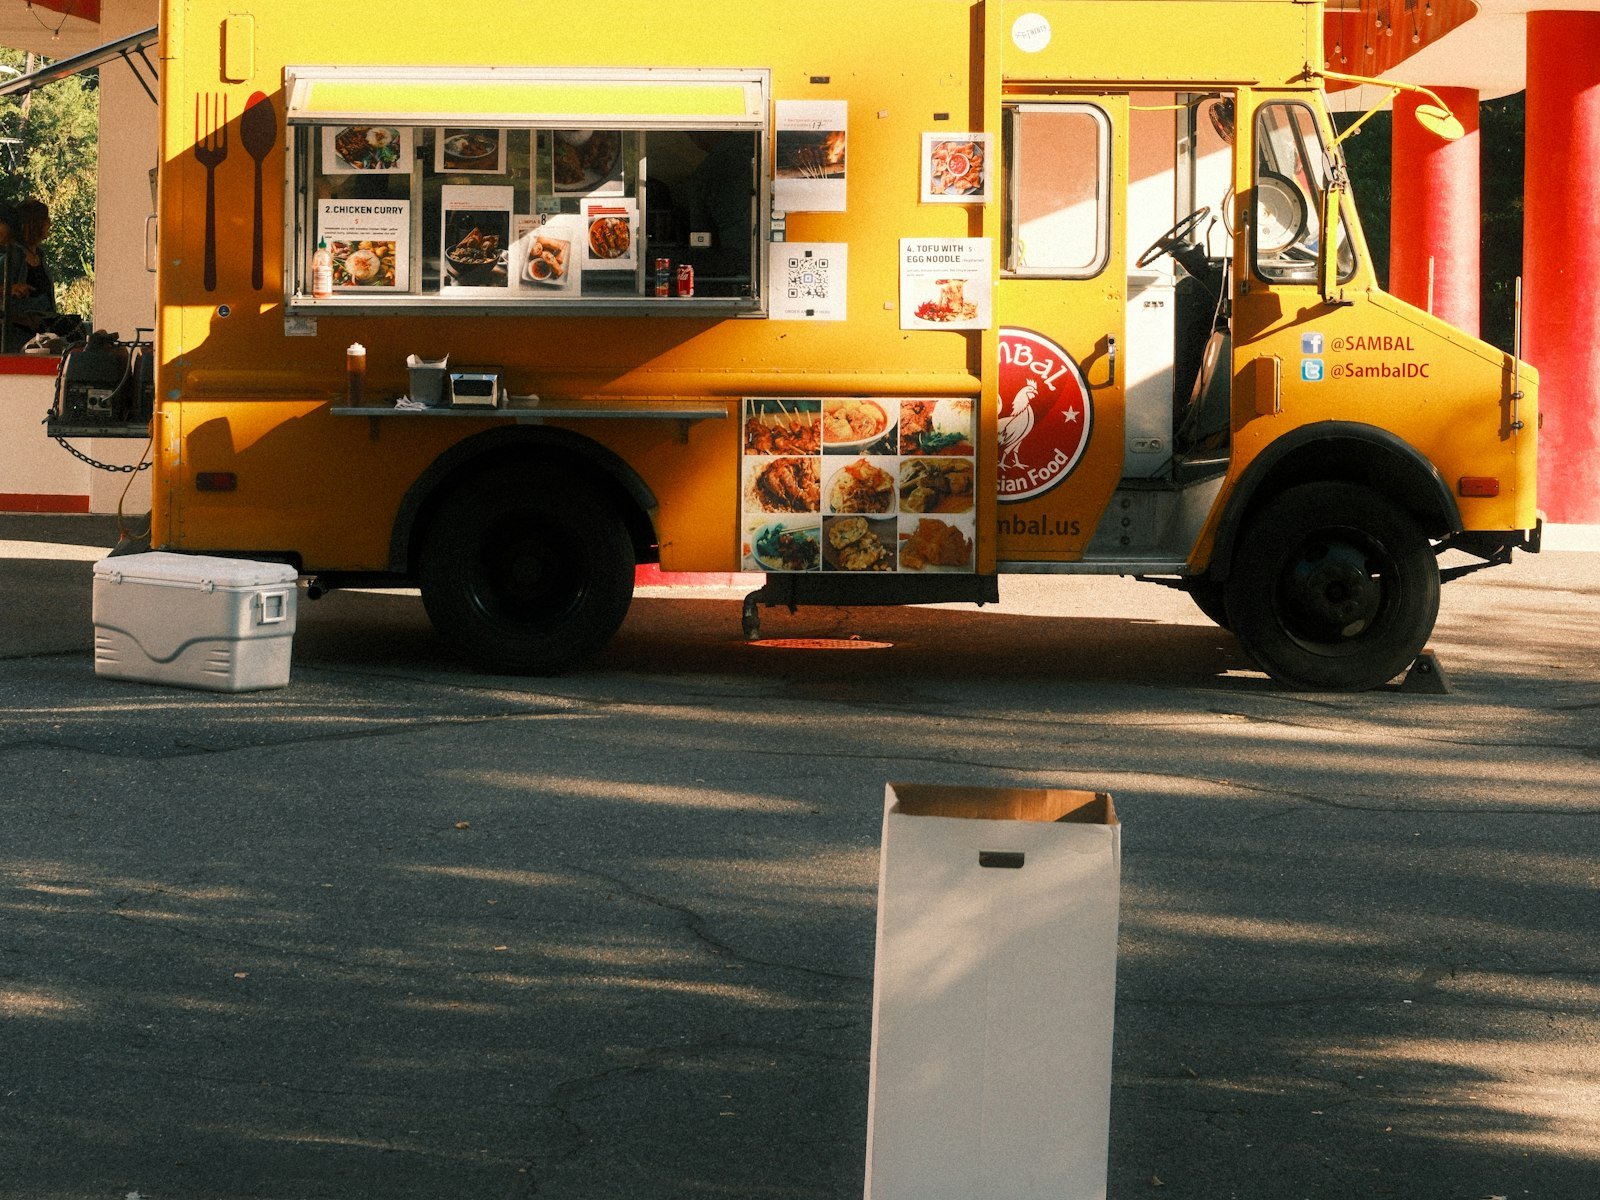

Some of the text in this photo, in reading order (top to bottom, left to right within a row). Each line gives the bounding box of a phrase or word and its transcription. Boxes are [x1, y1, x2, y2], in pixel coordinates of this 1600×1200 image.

[374, 206, 404, 215] CURRY
[906, 245, 914, 253] 4.
[917, 244, 940, 253] TOFU
[941, 244, 964, 253] WITH
[906, 255, 924, 263] EGG
[926, 255, 961, 263] NOODLE
[1330, 336, 1415, 352] @SAMBAL
[1330, 362, 1430, 379] @SambalDC
[1027, 448, 1069, 486] Food
